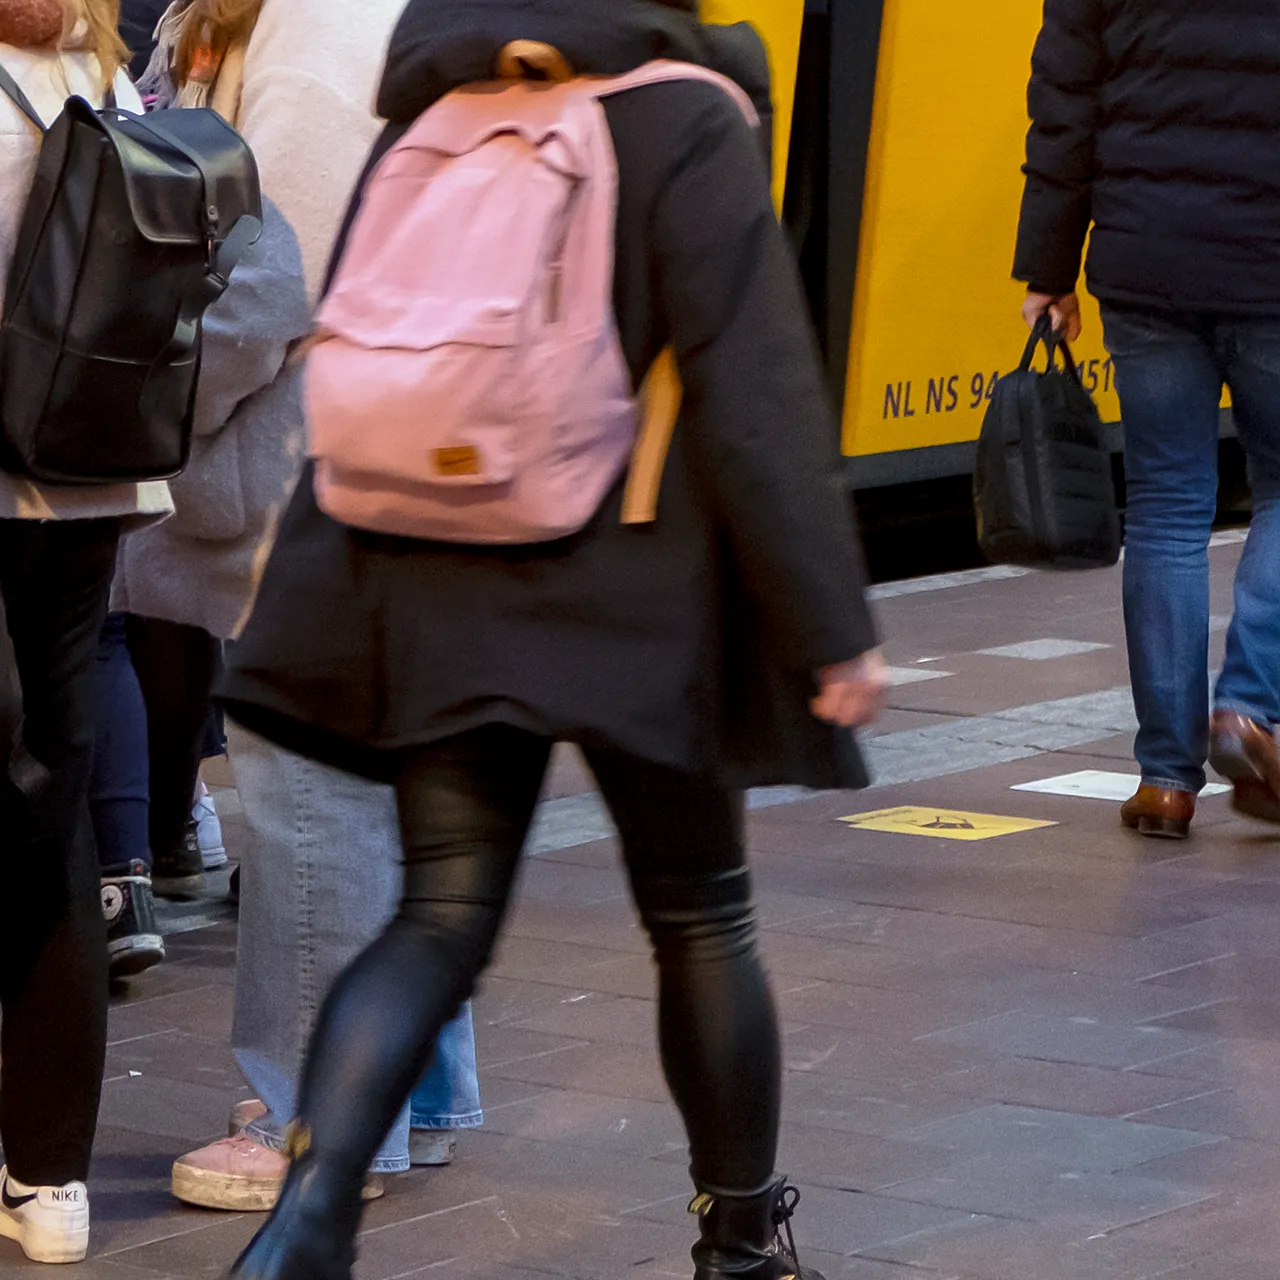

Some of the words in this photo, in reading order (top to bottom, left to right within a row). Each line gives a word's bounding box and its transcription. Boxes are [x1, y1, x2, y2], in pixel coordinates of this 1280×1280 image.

[883, 381, 915, 419] NL
[926, 375, 959, 414] NS
[51, 1190, 79, 1202] NIKE
